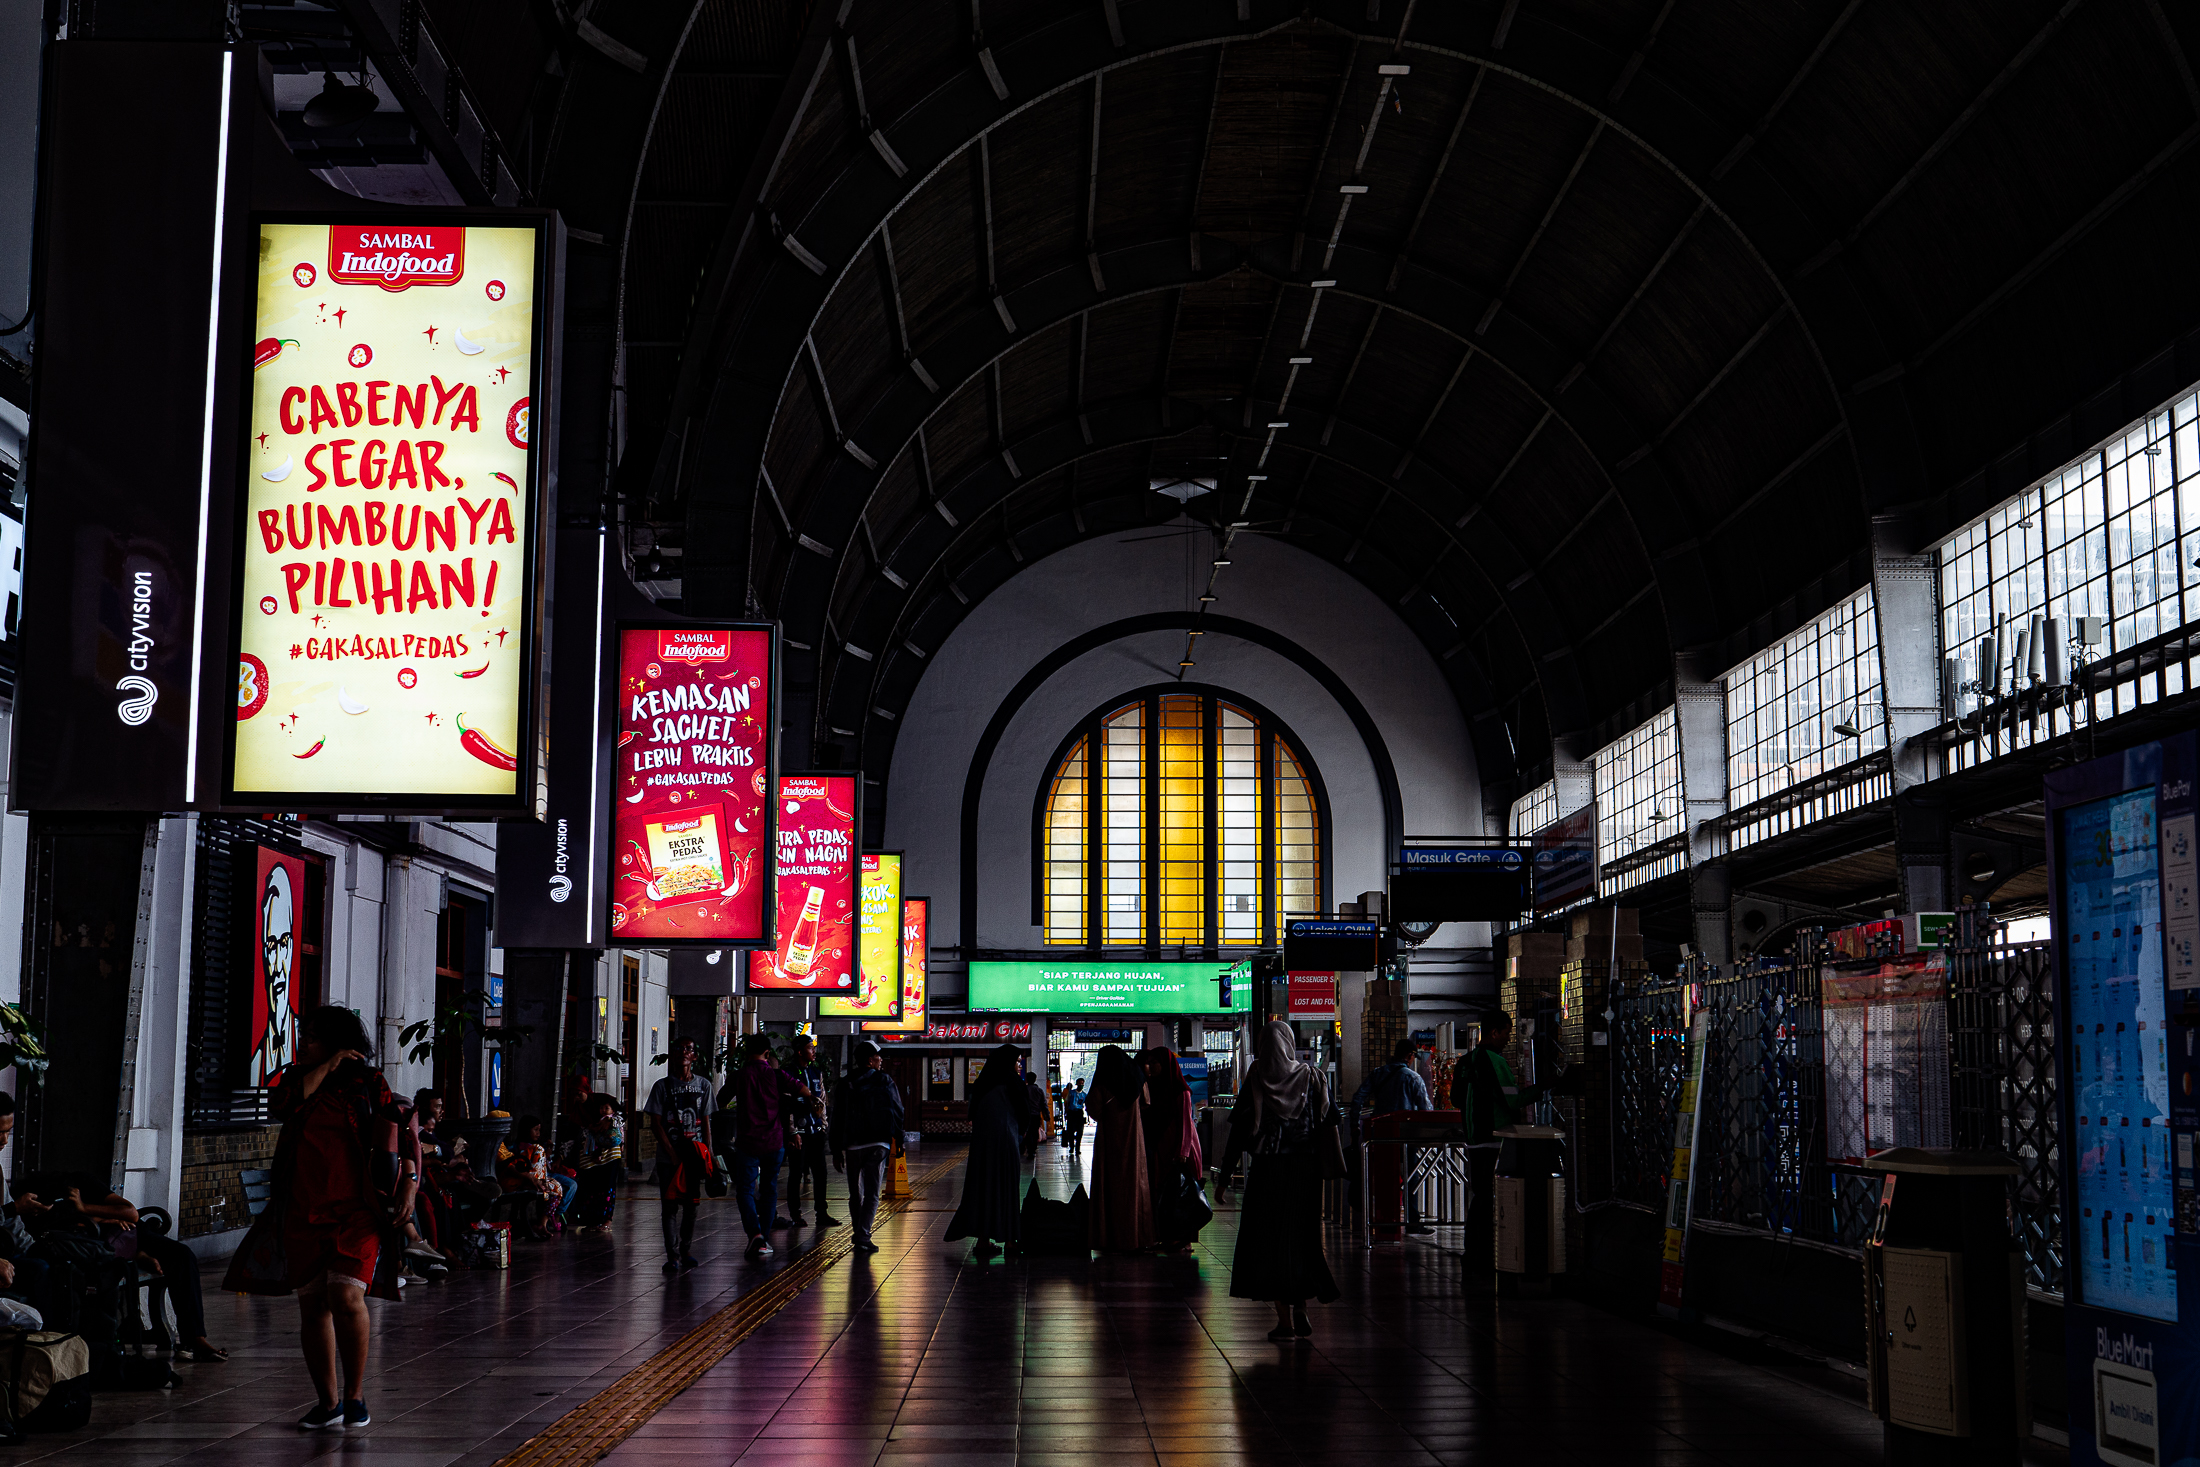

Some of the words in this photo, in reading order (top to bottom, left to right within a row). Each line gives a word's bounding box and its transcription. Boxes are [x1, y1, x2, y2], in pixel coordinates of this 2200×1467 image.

[360, 233, 435, 249] SAMBAL
[338, 252, 455, 281] Indofood
[280, 375, 480, 434] CABENYA
[305, 439, 464, 492] SEGAR,
[258, 497, 516, 555] BUMBUNYA
[281, 558, 500, 618] PILIHAN!
[127, 572, 155, 671] cityvision
[289, 633, 469, 661] #GAKASALPEDAS
[674, 633, 715, 643] SAMBAL
[663, 644, 726, 660] Indofood
[631, 683, 750, 722] KEMASAN
[648, 714, 737, 745] SACHET,
[634, 747, 682, 772] LEBIH
[691, 744, 754, 767] PRAKTIS
[647, 771, 734, 786] #GAKASALPEDAS
[782, 786, 825, 798] Indofood
[2163, 780, 2191, 800] BluePay
[665, 820, 699, 832] Indofood
[554, 818, 570, 873] cityvision
[668, 836, 704, 849] EKSTRA
[808, 828, 852, 846] PEDAS,
[672, 845, 703, 858] PEDAS
[805, 844, 847, 863] NAGIH
[1406, 852, 1452, 864] Masuk
[1455, 852, 1491, 864] Gate
[862, 902, 888, 914] ASAM
[1071, 972, 1121, 980] TERJANG
[1124, 972, 1164, 980] HUJAN,
[1294, 975, 1328, 983] PASSENGER
[1294, 998, 1309, 1006] LOST
[1310, 998, 1323, 1006] AND
[994, 1021, 1030, 1038] GM
[2096, 1326, 2154, 1371] BlueMart
[2110, 1400, 2131, 1420] Ambil
[2132, 1406, 2154, 1426] Disini
